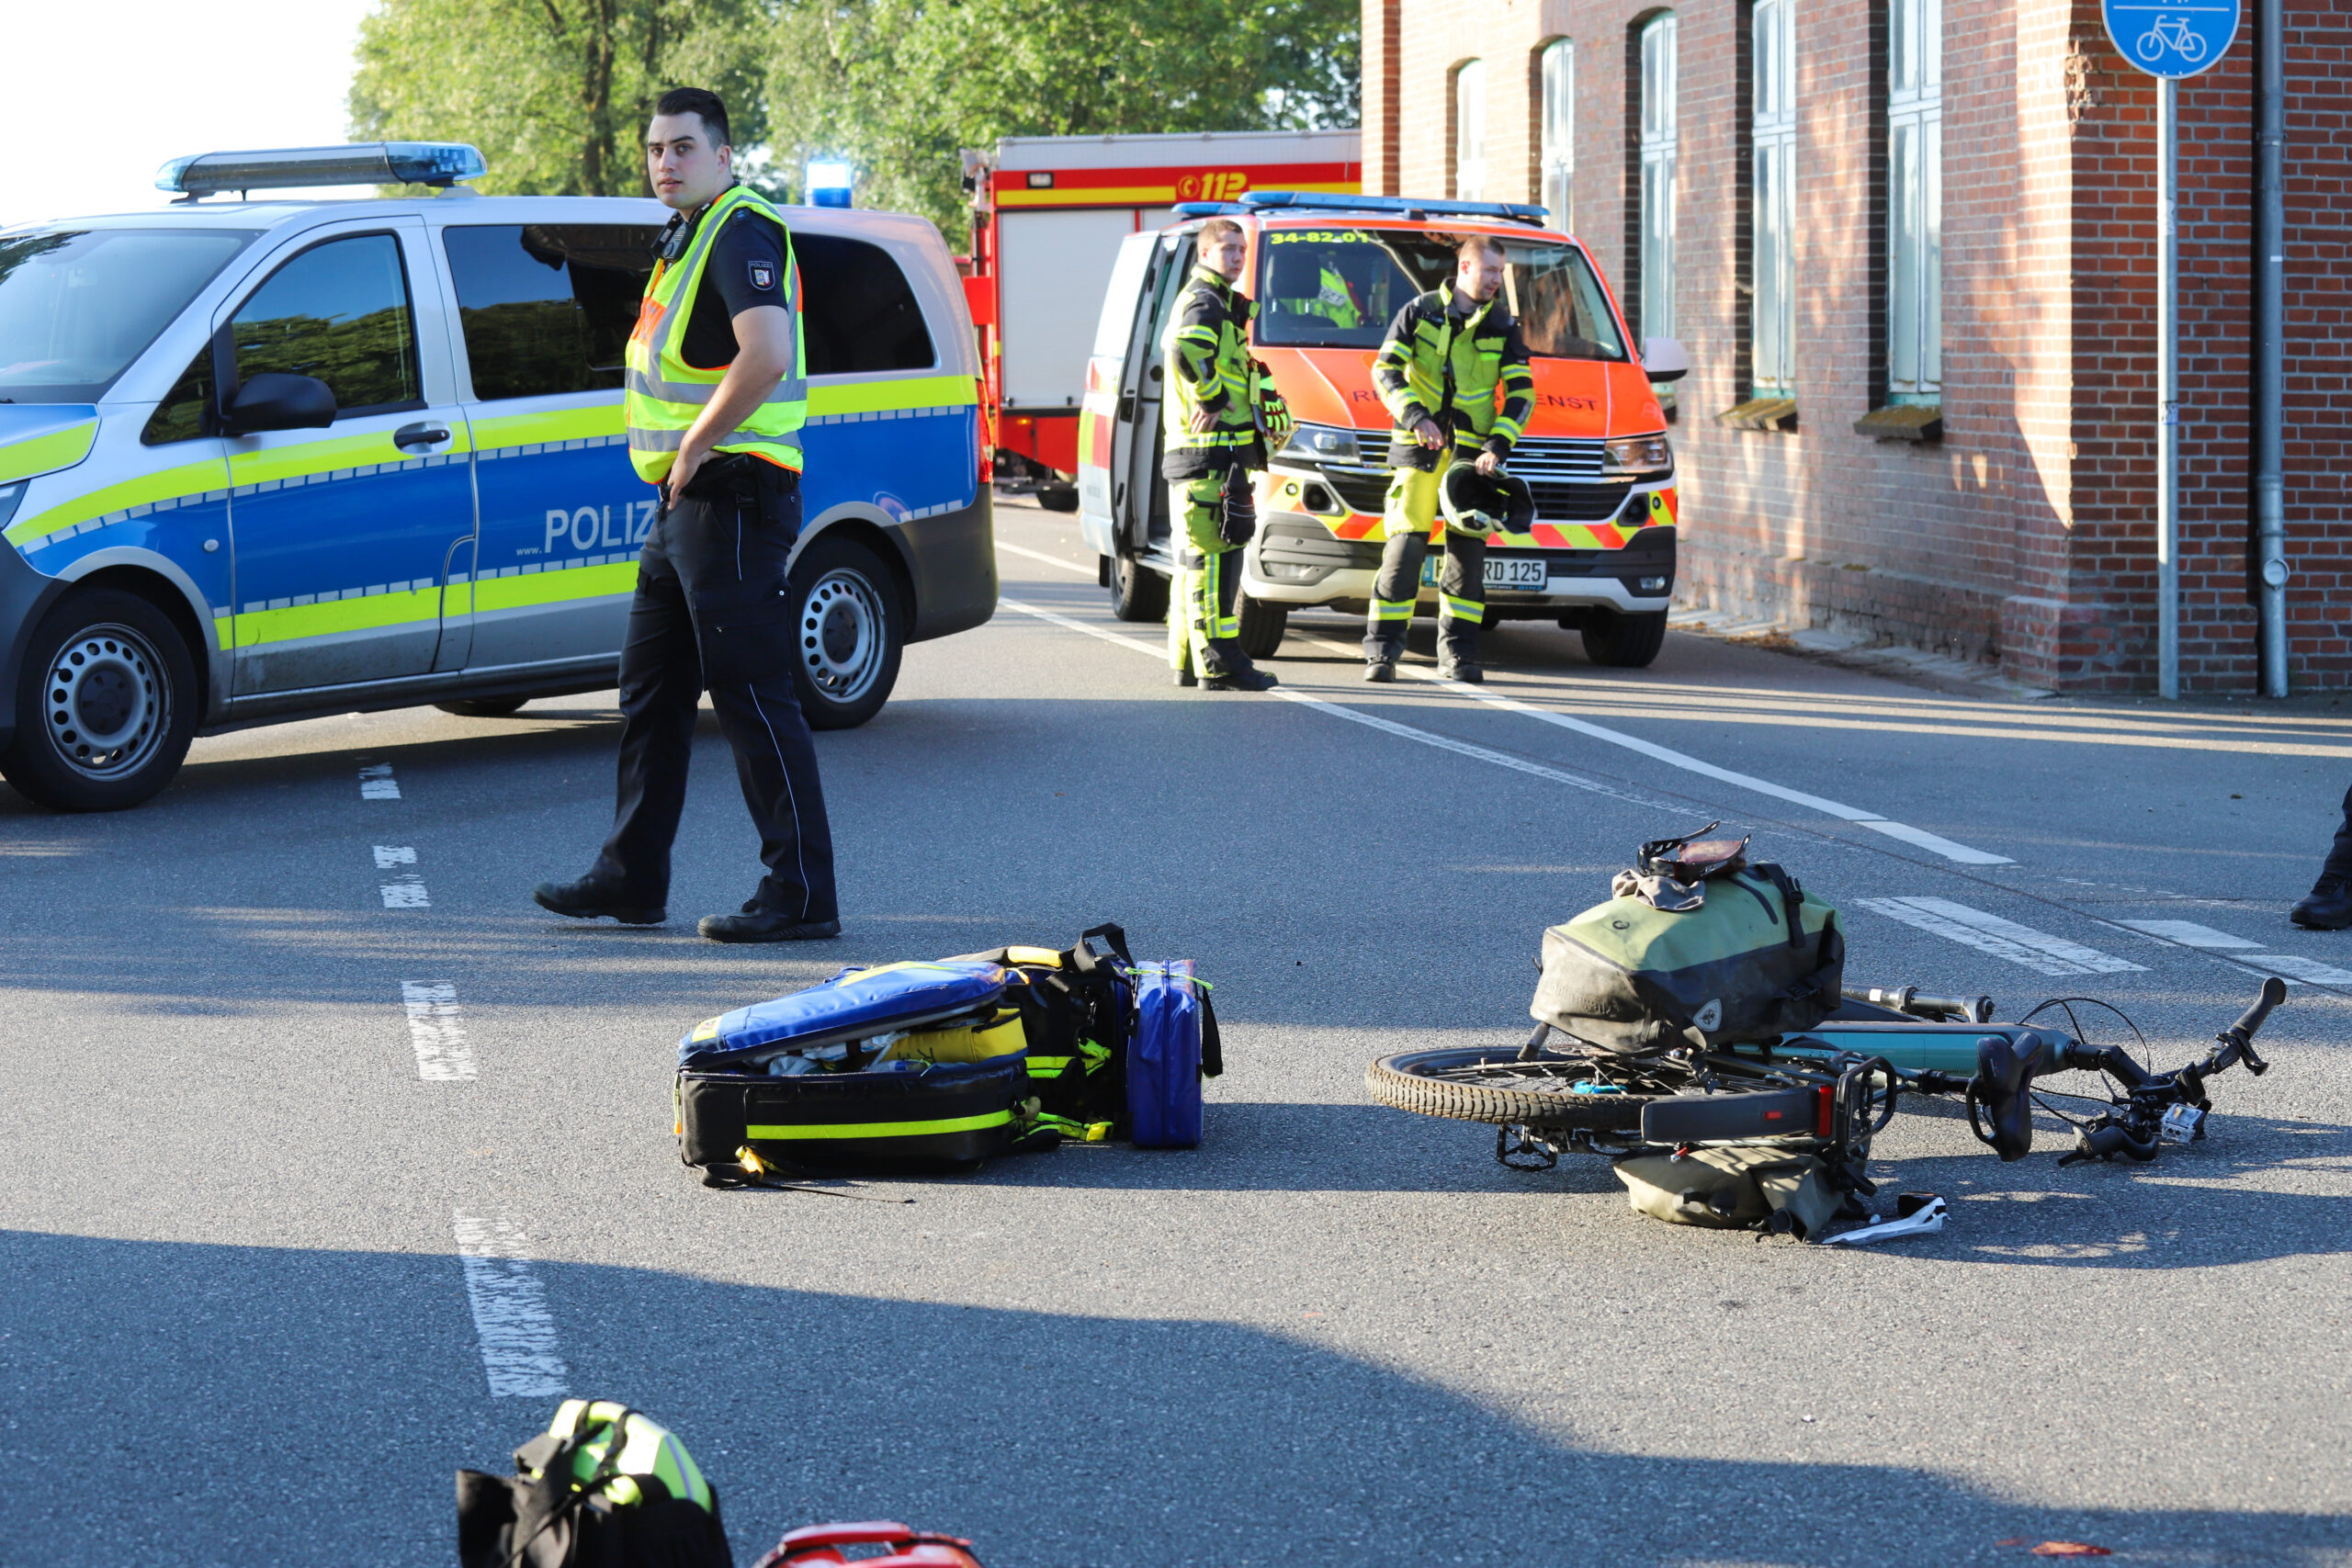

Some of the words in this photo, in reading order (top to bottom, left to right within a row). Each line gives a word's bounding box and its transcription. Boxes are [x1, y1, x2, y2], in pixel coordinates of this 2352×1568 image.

[1201, 173, 1248, 200] 112
[1271, 231, 1368, 244] 34-82-01
[1510, 561, 1542, 582] 125
